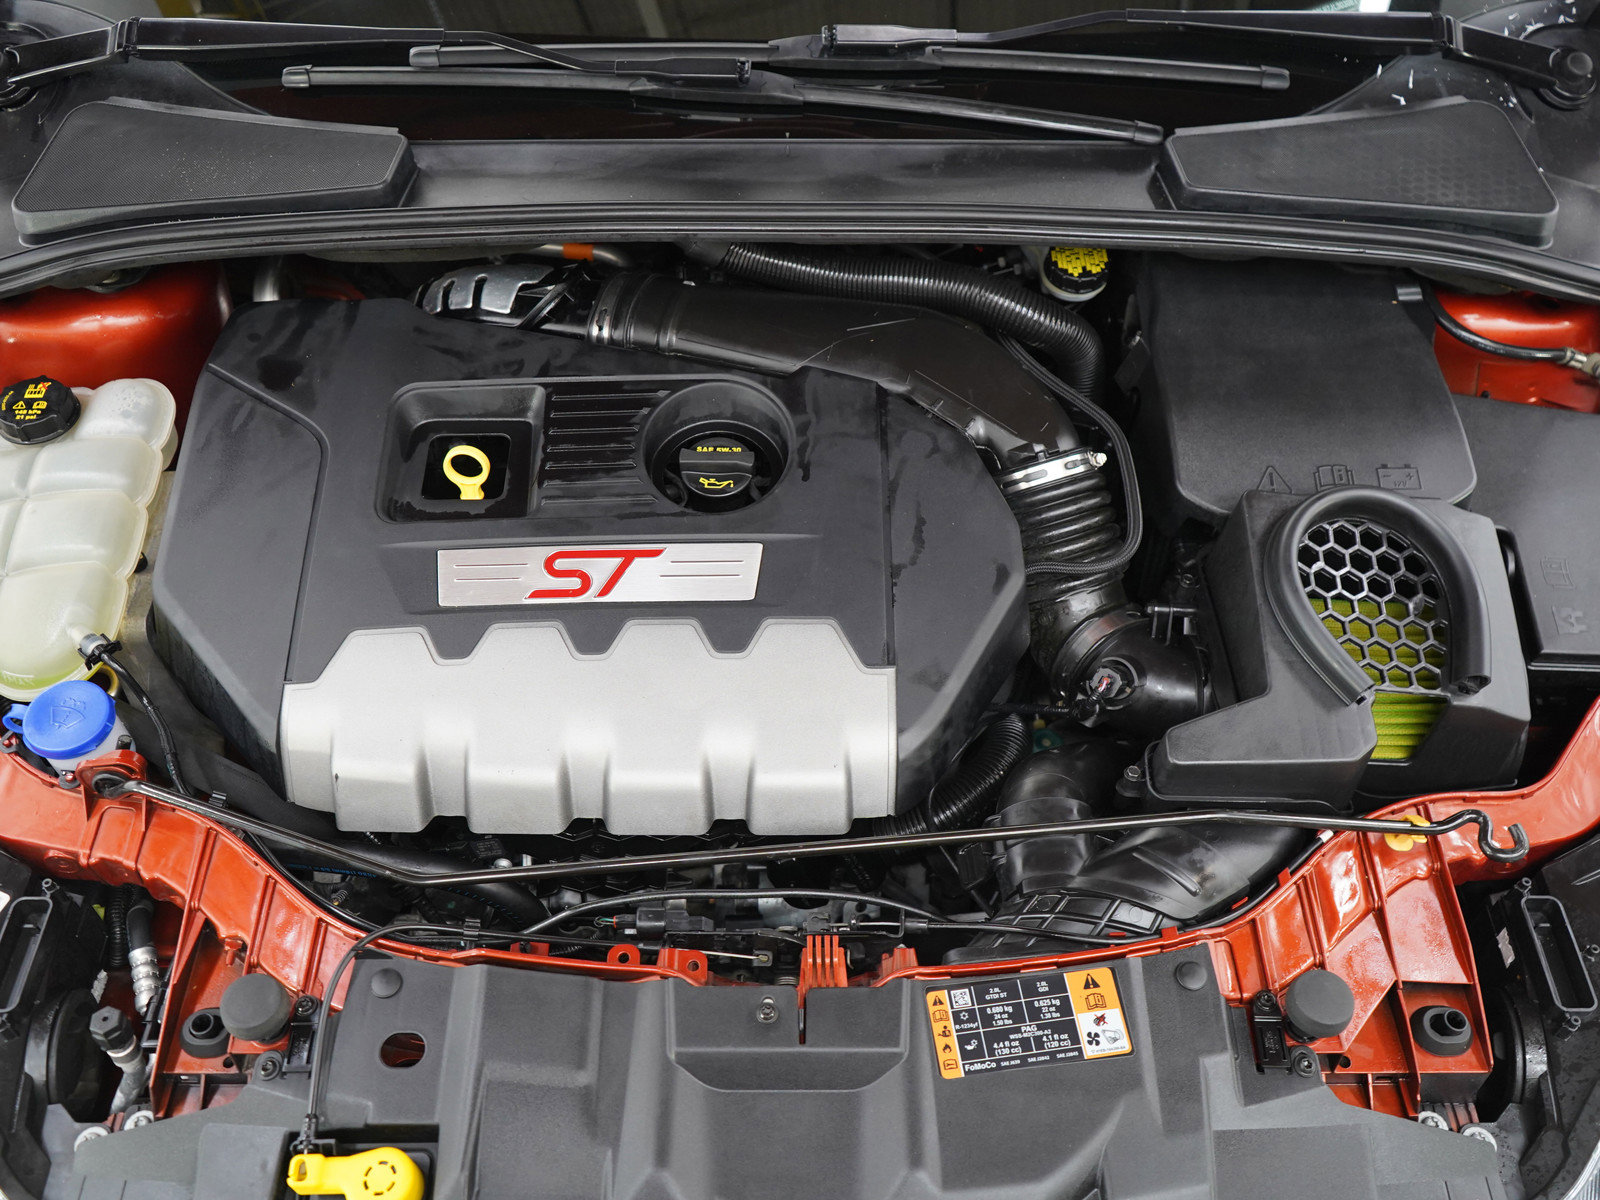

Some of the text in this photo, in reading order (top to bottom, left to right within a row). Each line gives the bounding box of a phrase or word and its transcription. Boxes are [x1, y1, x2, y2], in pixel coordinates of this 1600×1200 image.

[524, 547, 667, 599] ST
[1021, 1025, 1037, 1033] PAG
[995, 1048, 1010, 1056] (130
[965, 1061, 996, 1071] FoMoCo
